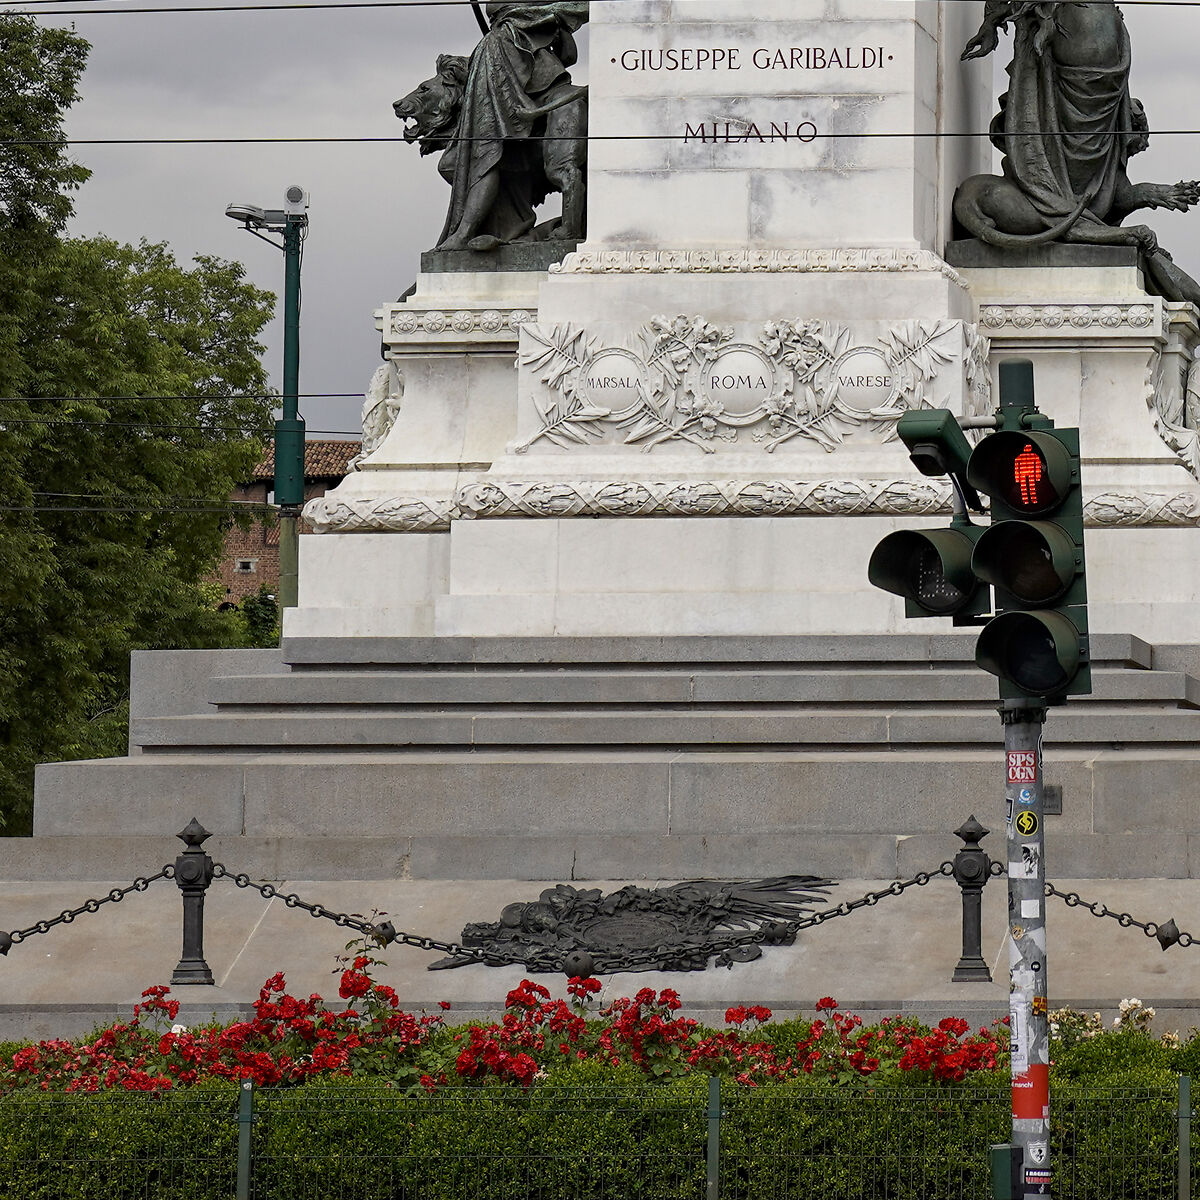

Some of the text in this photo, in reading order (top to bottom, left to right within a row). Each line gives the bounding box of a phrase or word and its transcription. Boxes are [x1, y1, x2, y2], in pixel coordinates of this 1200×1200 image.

[684, 121, 818, 144] MILANO
[587, 376, 642, 390] MARSALA
[710, 375, 768, 390] ROMA
[838, 375, 892, 389] VARESE
[1008, 753, 1035, 766] SPS
[1008, 767, 1035, 779] CGN
